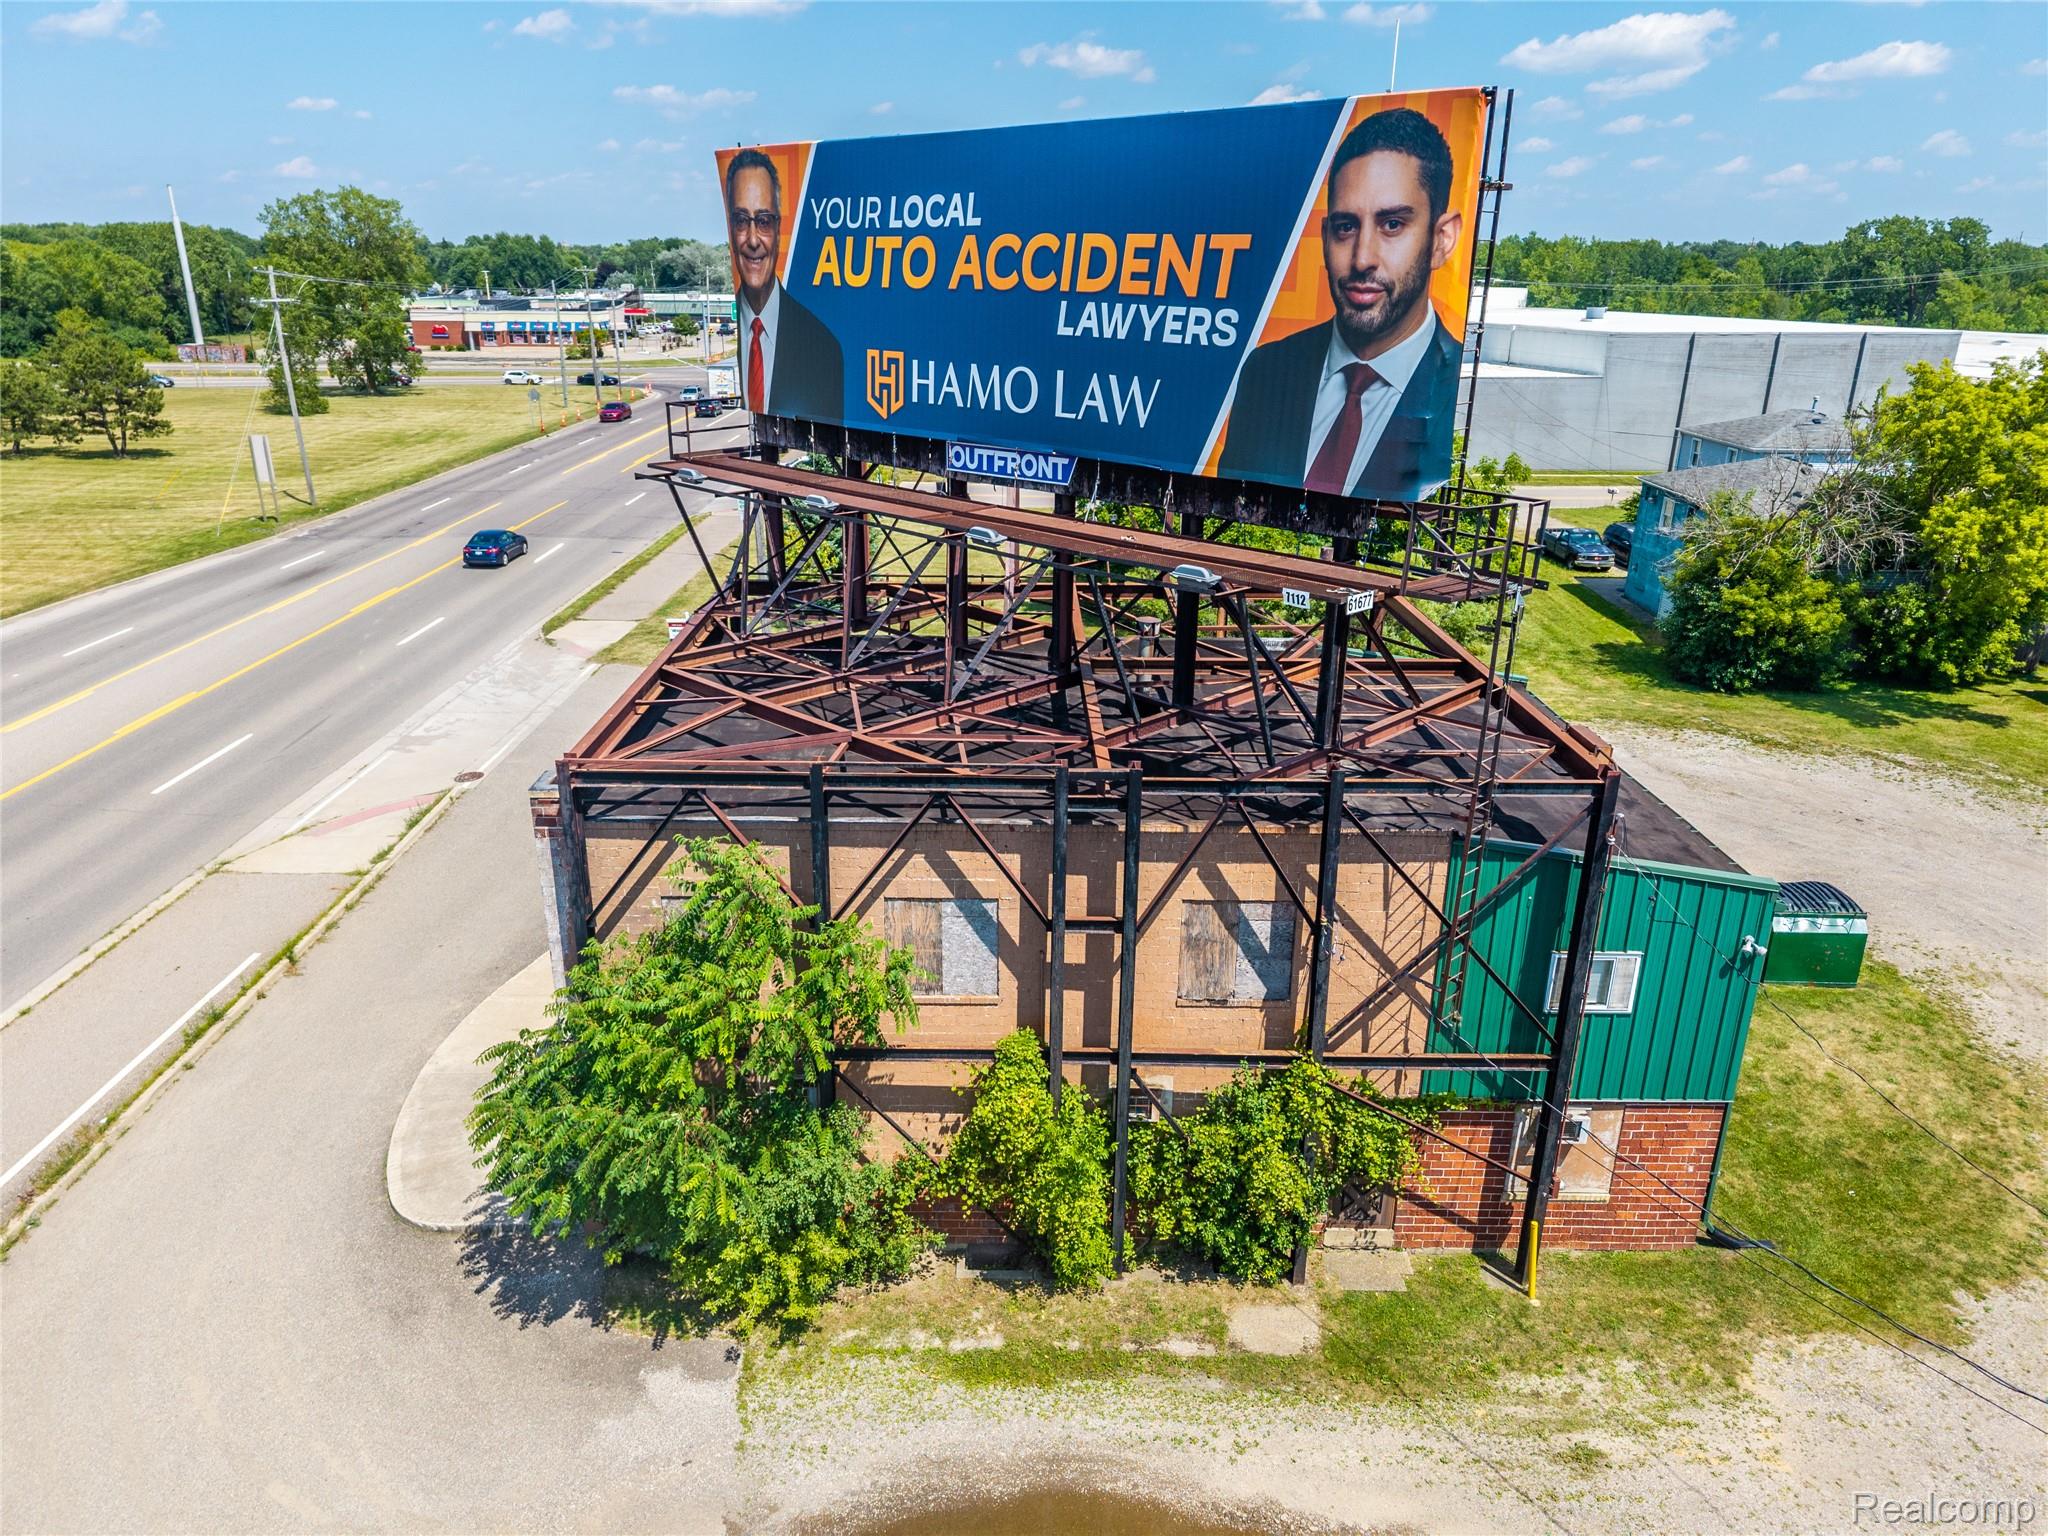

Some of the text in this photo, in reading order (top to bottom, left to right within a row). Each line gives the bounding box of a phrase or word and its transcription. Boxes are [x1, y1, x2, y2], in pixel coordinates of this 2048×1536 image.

[811, 192, 982, 229] YOUR LOCAL
[812, 233, 1252, 298] AUTO ACCIDENT
[1057, 301, 1239, 347] LAWYERS
[911, 360, 1161, 428] HAMO LAW
[950, 446, 1070, 480] OUTFRONT
[1348, 594, 1373, 612] 61677
